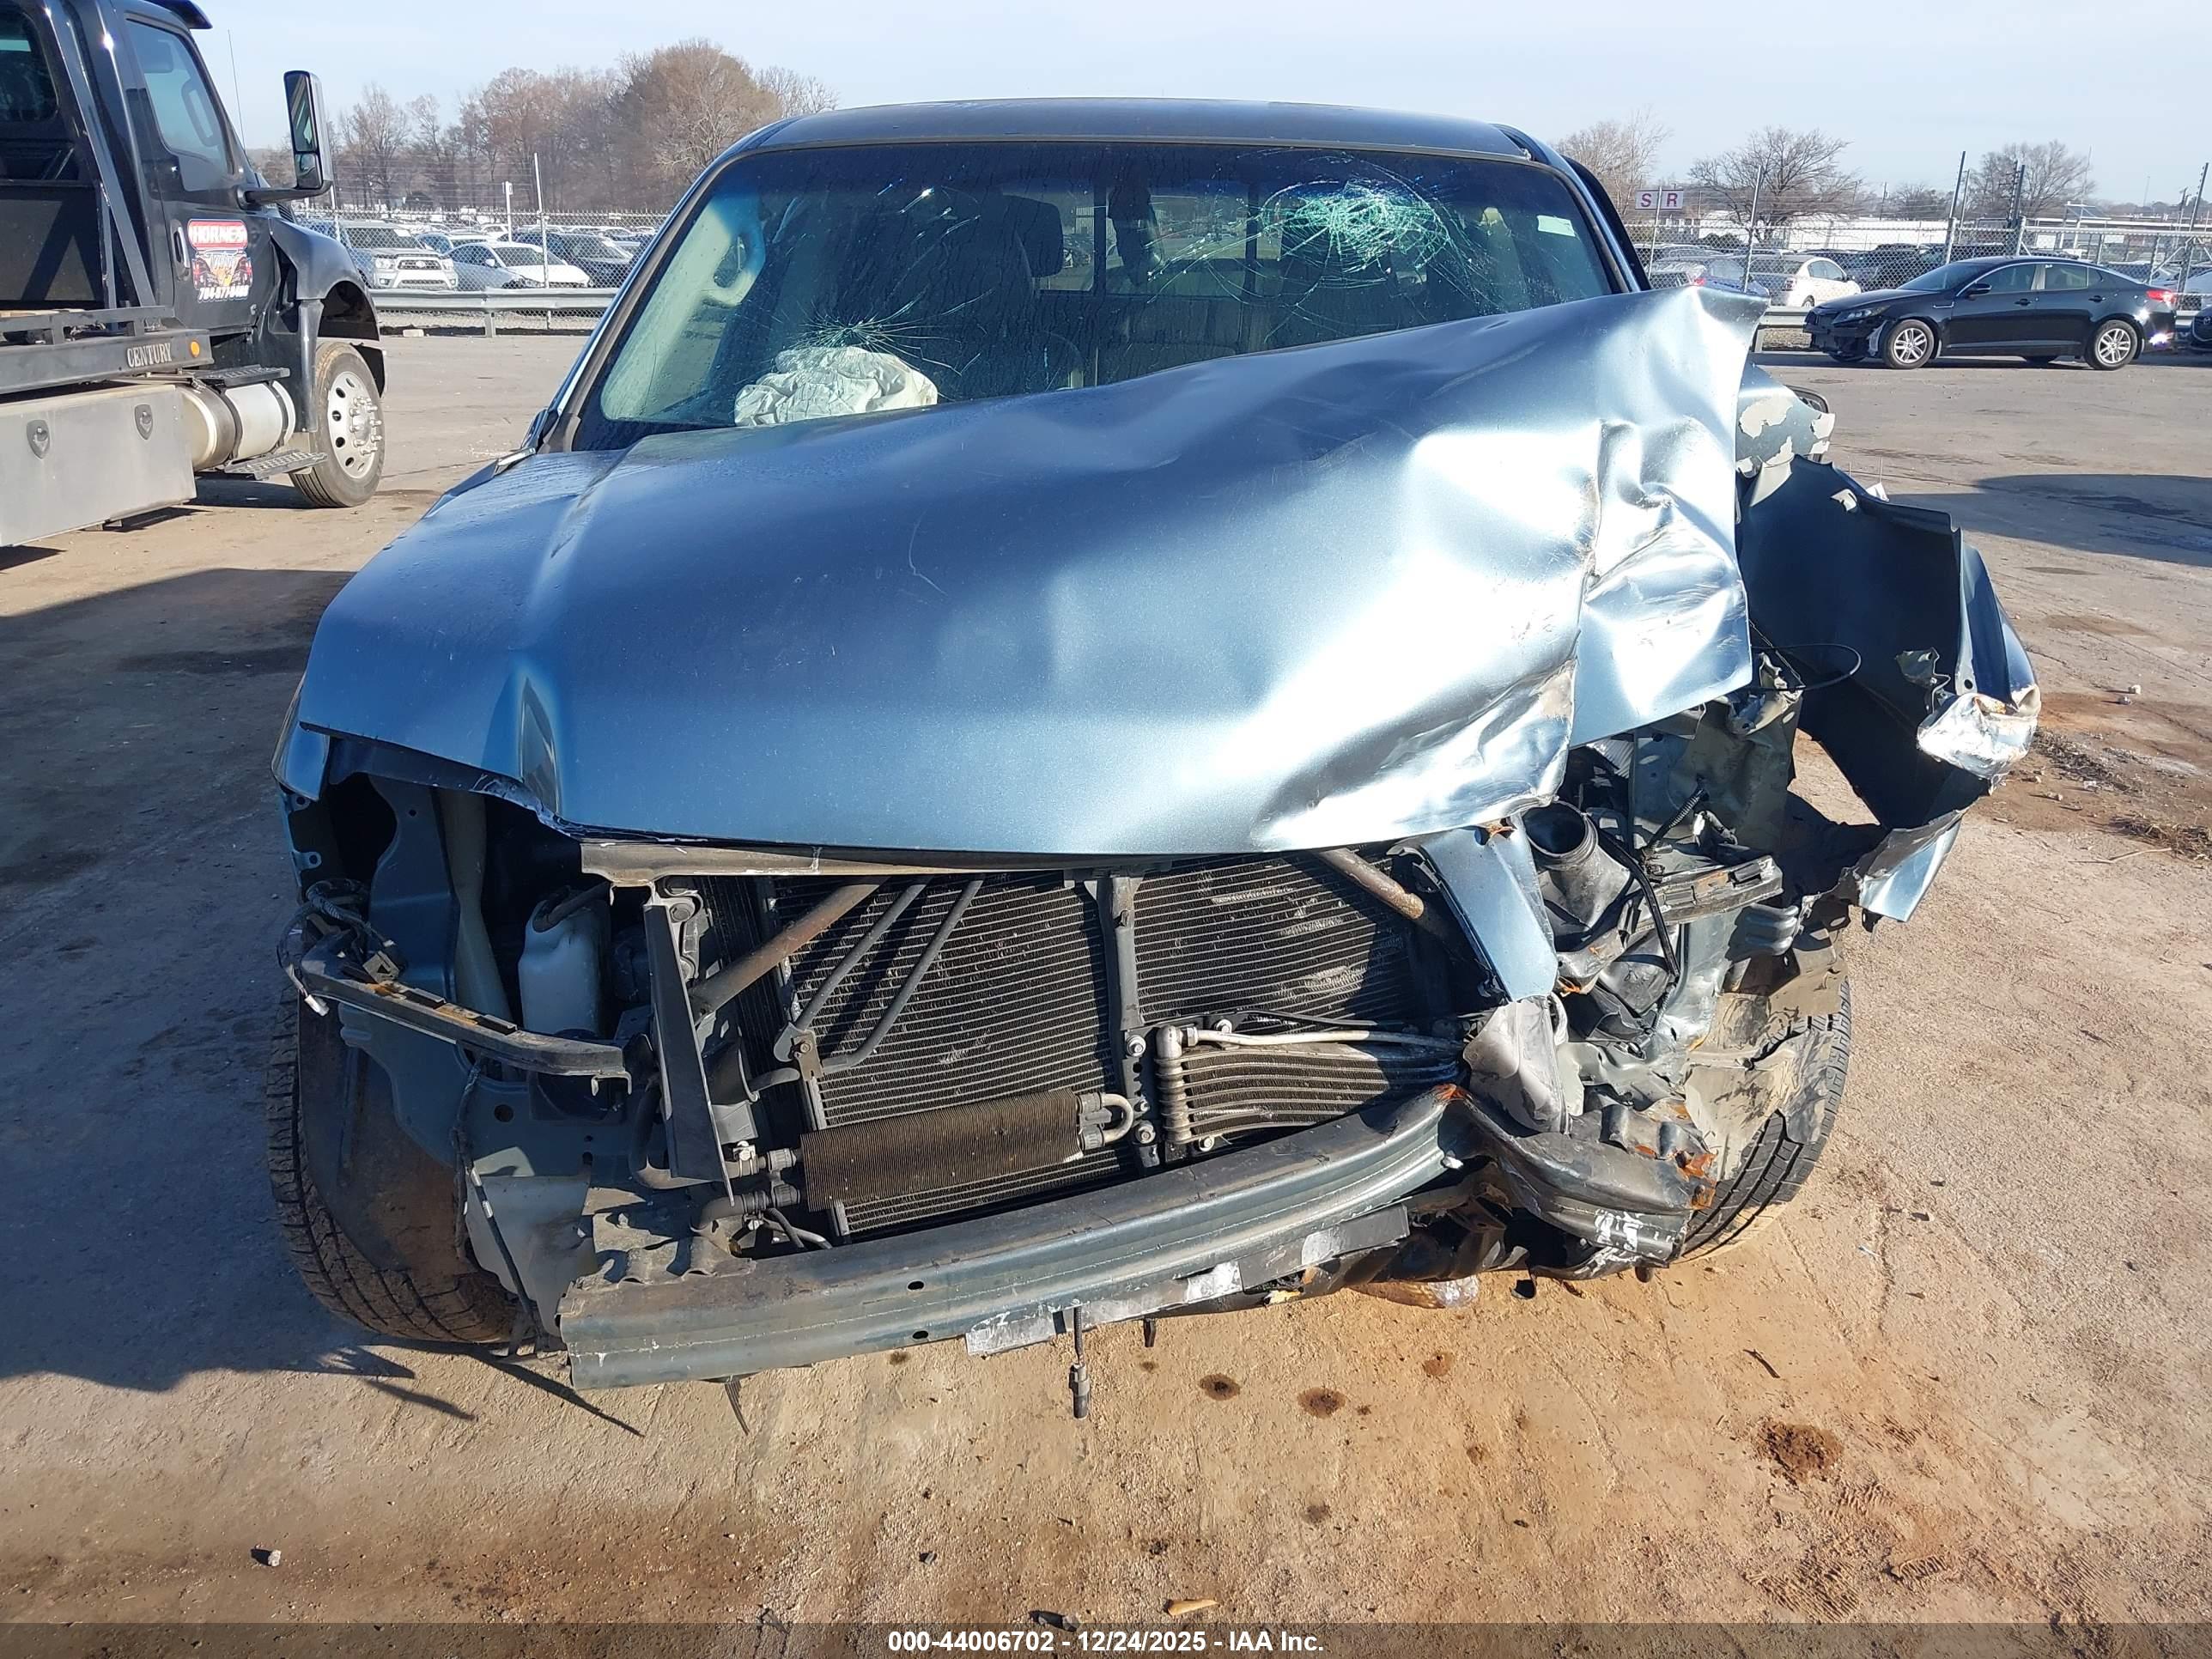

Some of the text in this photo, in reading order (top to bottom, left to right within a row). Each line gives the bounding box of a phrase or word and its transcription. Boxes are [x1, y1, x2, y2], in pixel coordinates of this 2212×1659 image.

[1640, 192, 1679, 208] S R
[126, 342, 173, 368] CENTURY
